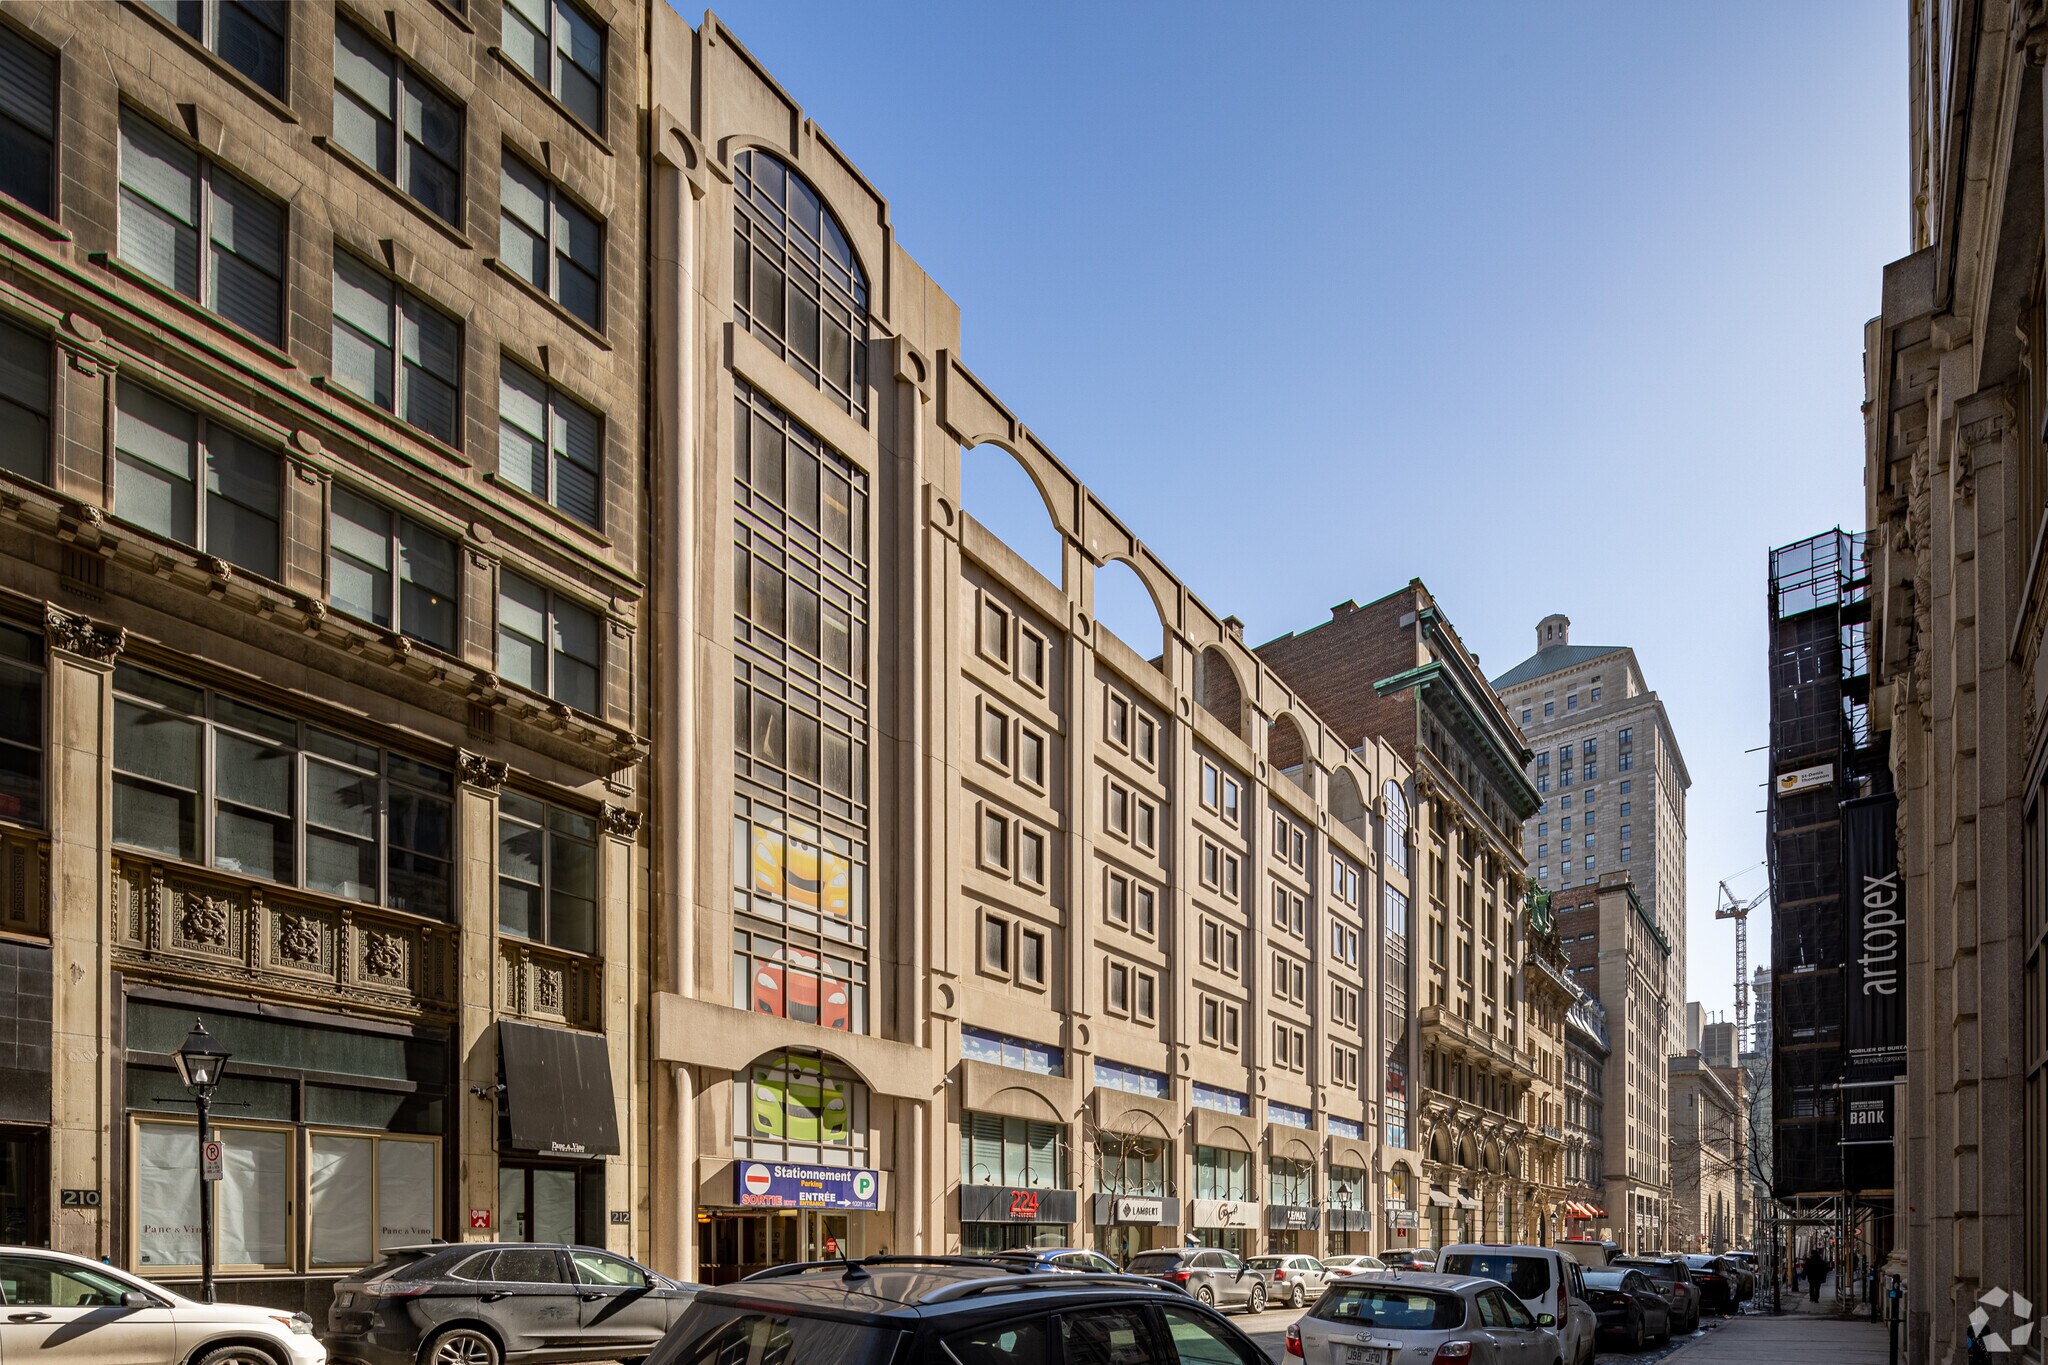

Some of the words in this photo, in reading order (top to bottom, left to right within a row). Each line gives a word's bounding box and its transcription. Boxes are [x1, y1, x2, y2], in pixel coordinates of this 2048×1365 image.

[1857, 871, 1905, 995] artopex
[774, 1165, 852, 1182] Stationnement
[800, 1179, 823, 1189] Parking
[859, 1178, 870, 1194] P
[63, 1191, 100, 1205] 210
[741, 1194, 783, 1206] SORTIE
[799, 1191, 836, 1203] ENTRÉE
[1010, 1190, 1039, 1212] 224
[612, 1212, 630, 1222] 212
[1132, 1206, 1158, 1216] LAMBERT
[144, 1225, 171, 1233] Pane
[183, 1225, 202, 1233] Vin
[382, 1226, 403, 1234] Pane
